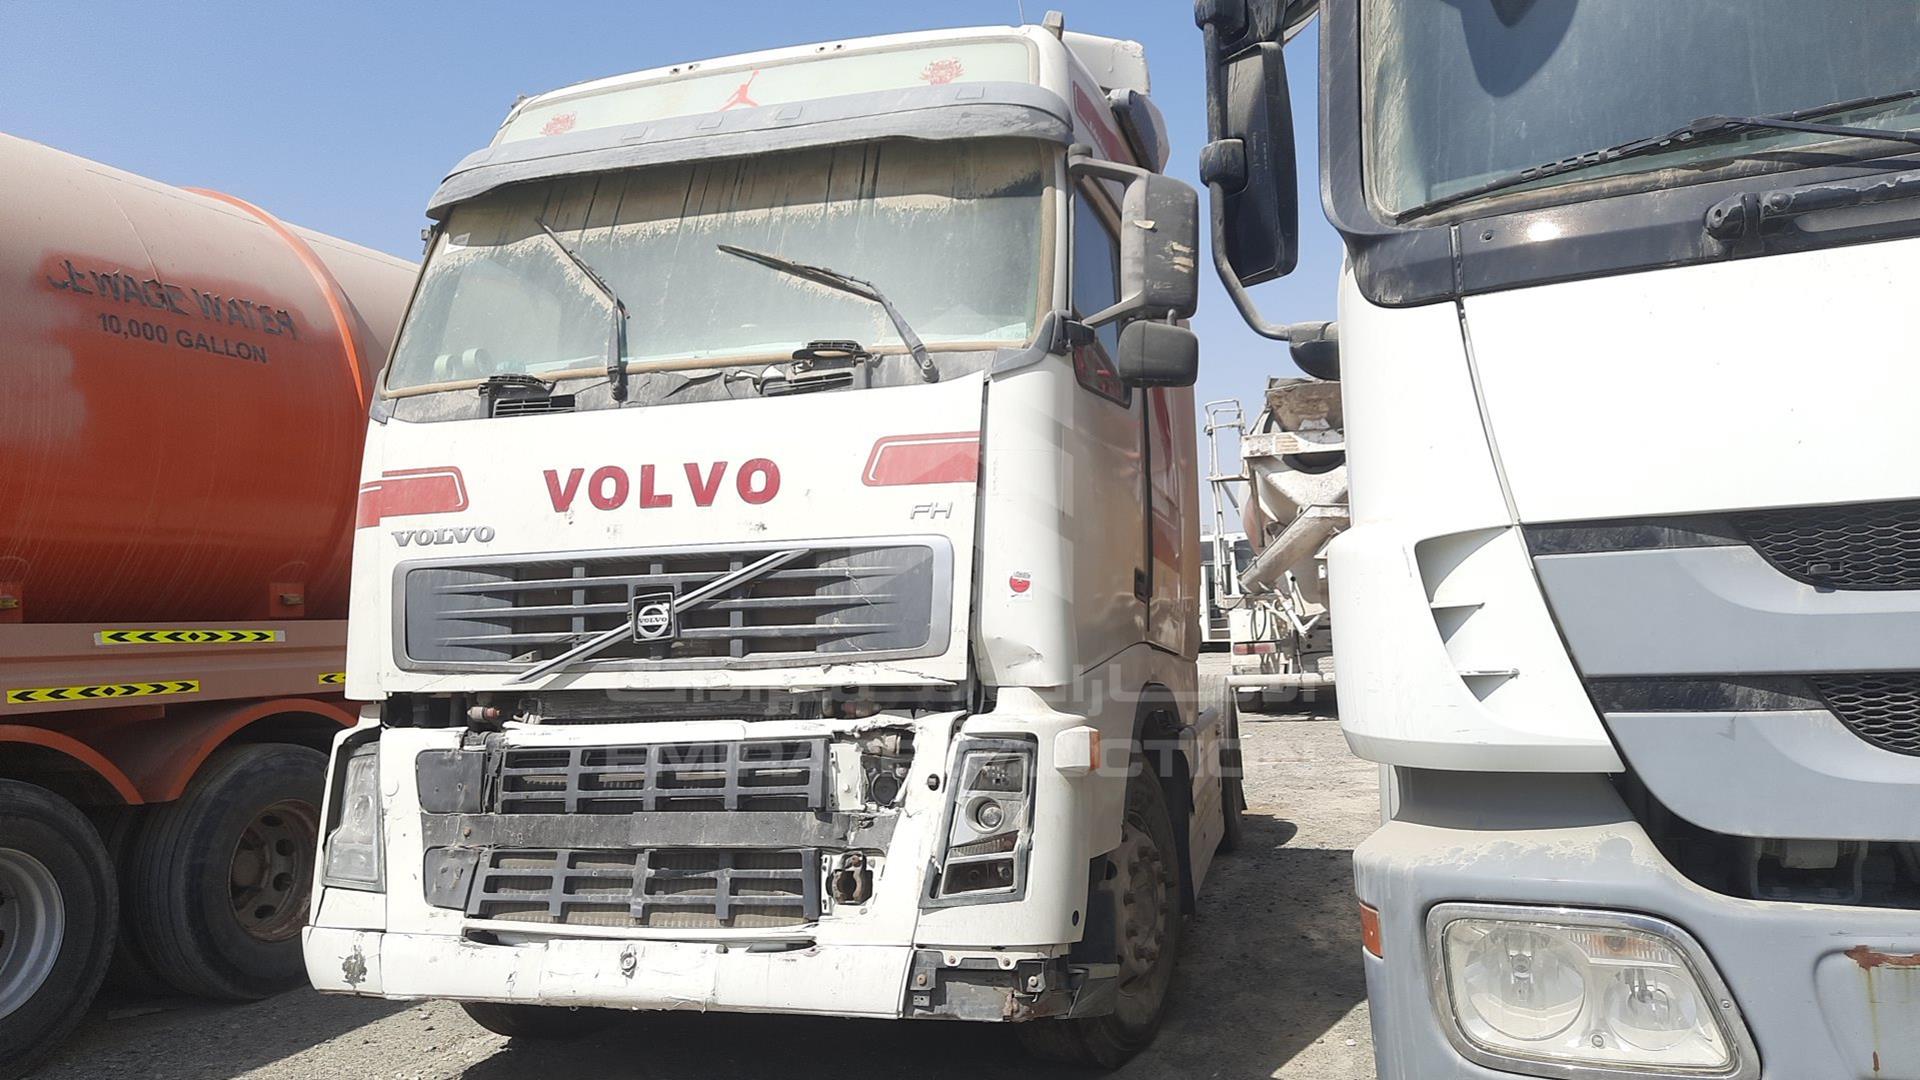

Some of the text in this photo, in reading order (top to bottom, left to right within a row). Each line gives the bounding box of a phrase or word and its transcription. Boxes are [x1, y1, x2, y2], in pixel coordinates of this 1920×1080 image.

[98, 313, 267, 364] 10,000 GALLON
[543, 457, 781, 513] VOLVO
[910, 501, 953, 519] FH
[391, 525, 496, 548] VOLVO
